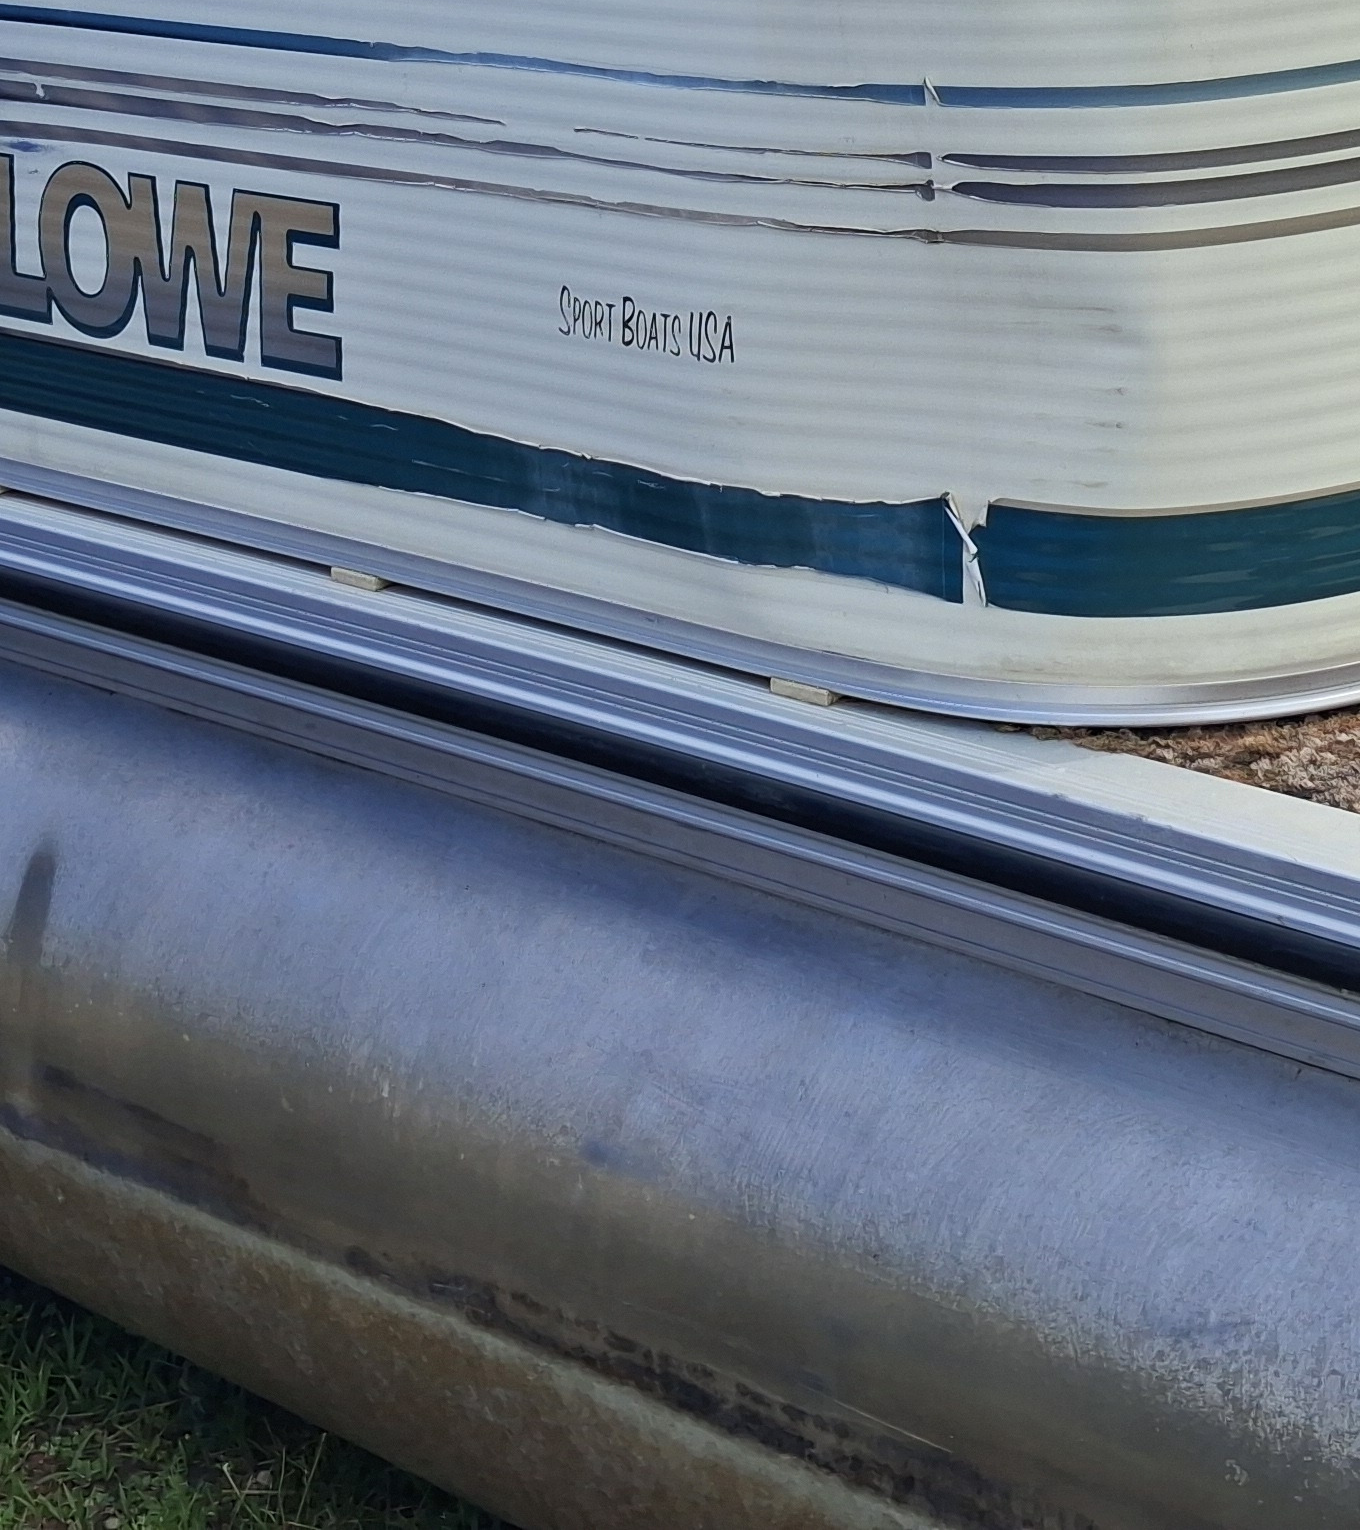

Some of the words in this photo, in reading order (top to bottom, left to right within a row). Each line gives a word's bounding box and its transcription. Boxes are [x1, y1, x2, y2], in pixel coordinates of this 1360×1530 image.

[558, 285, 616, 342] SPORT
[621, 296, 681, 356] BOATS
[689, 310, 735, 363] USA
